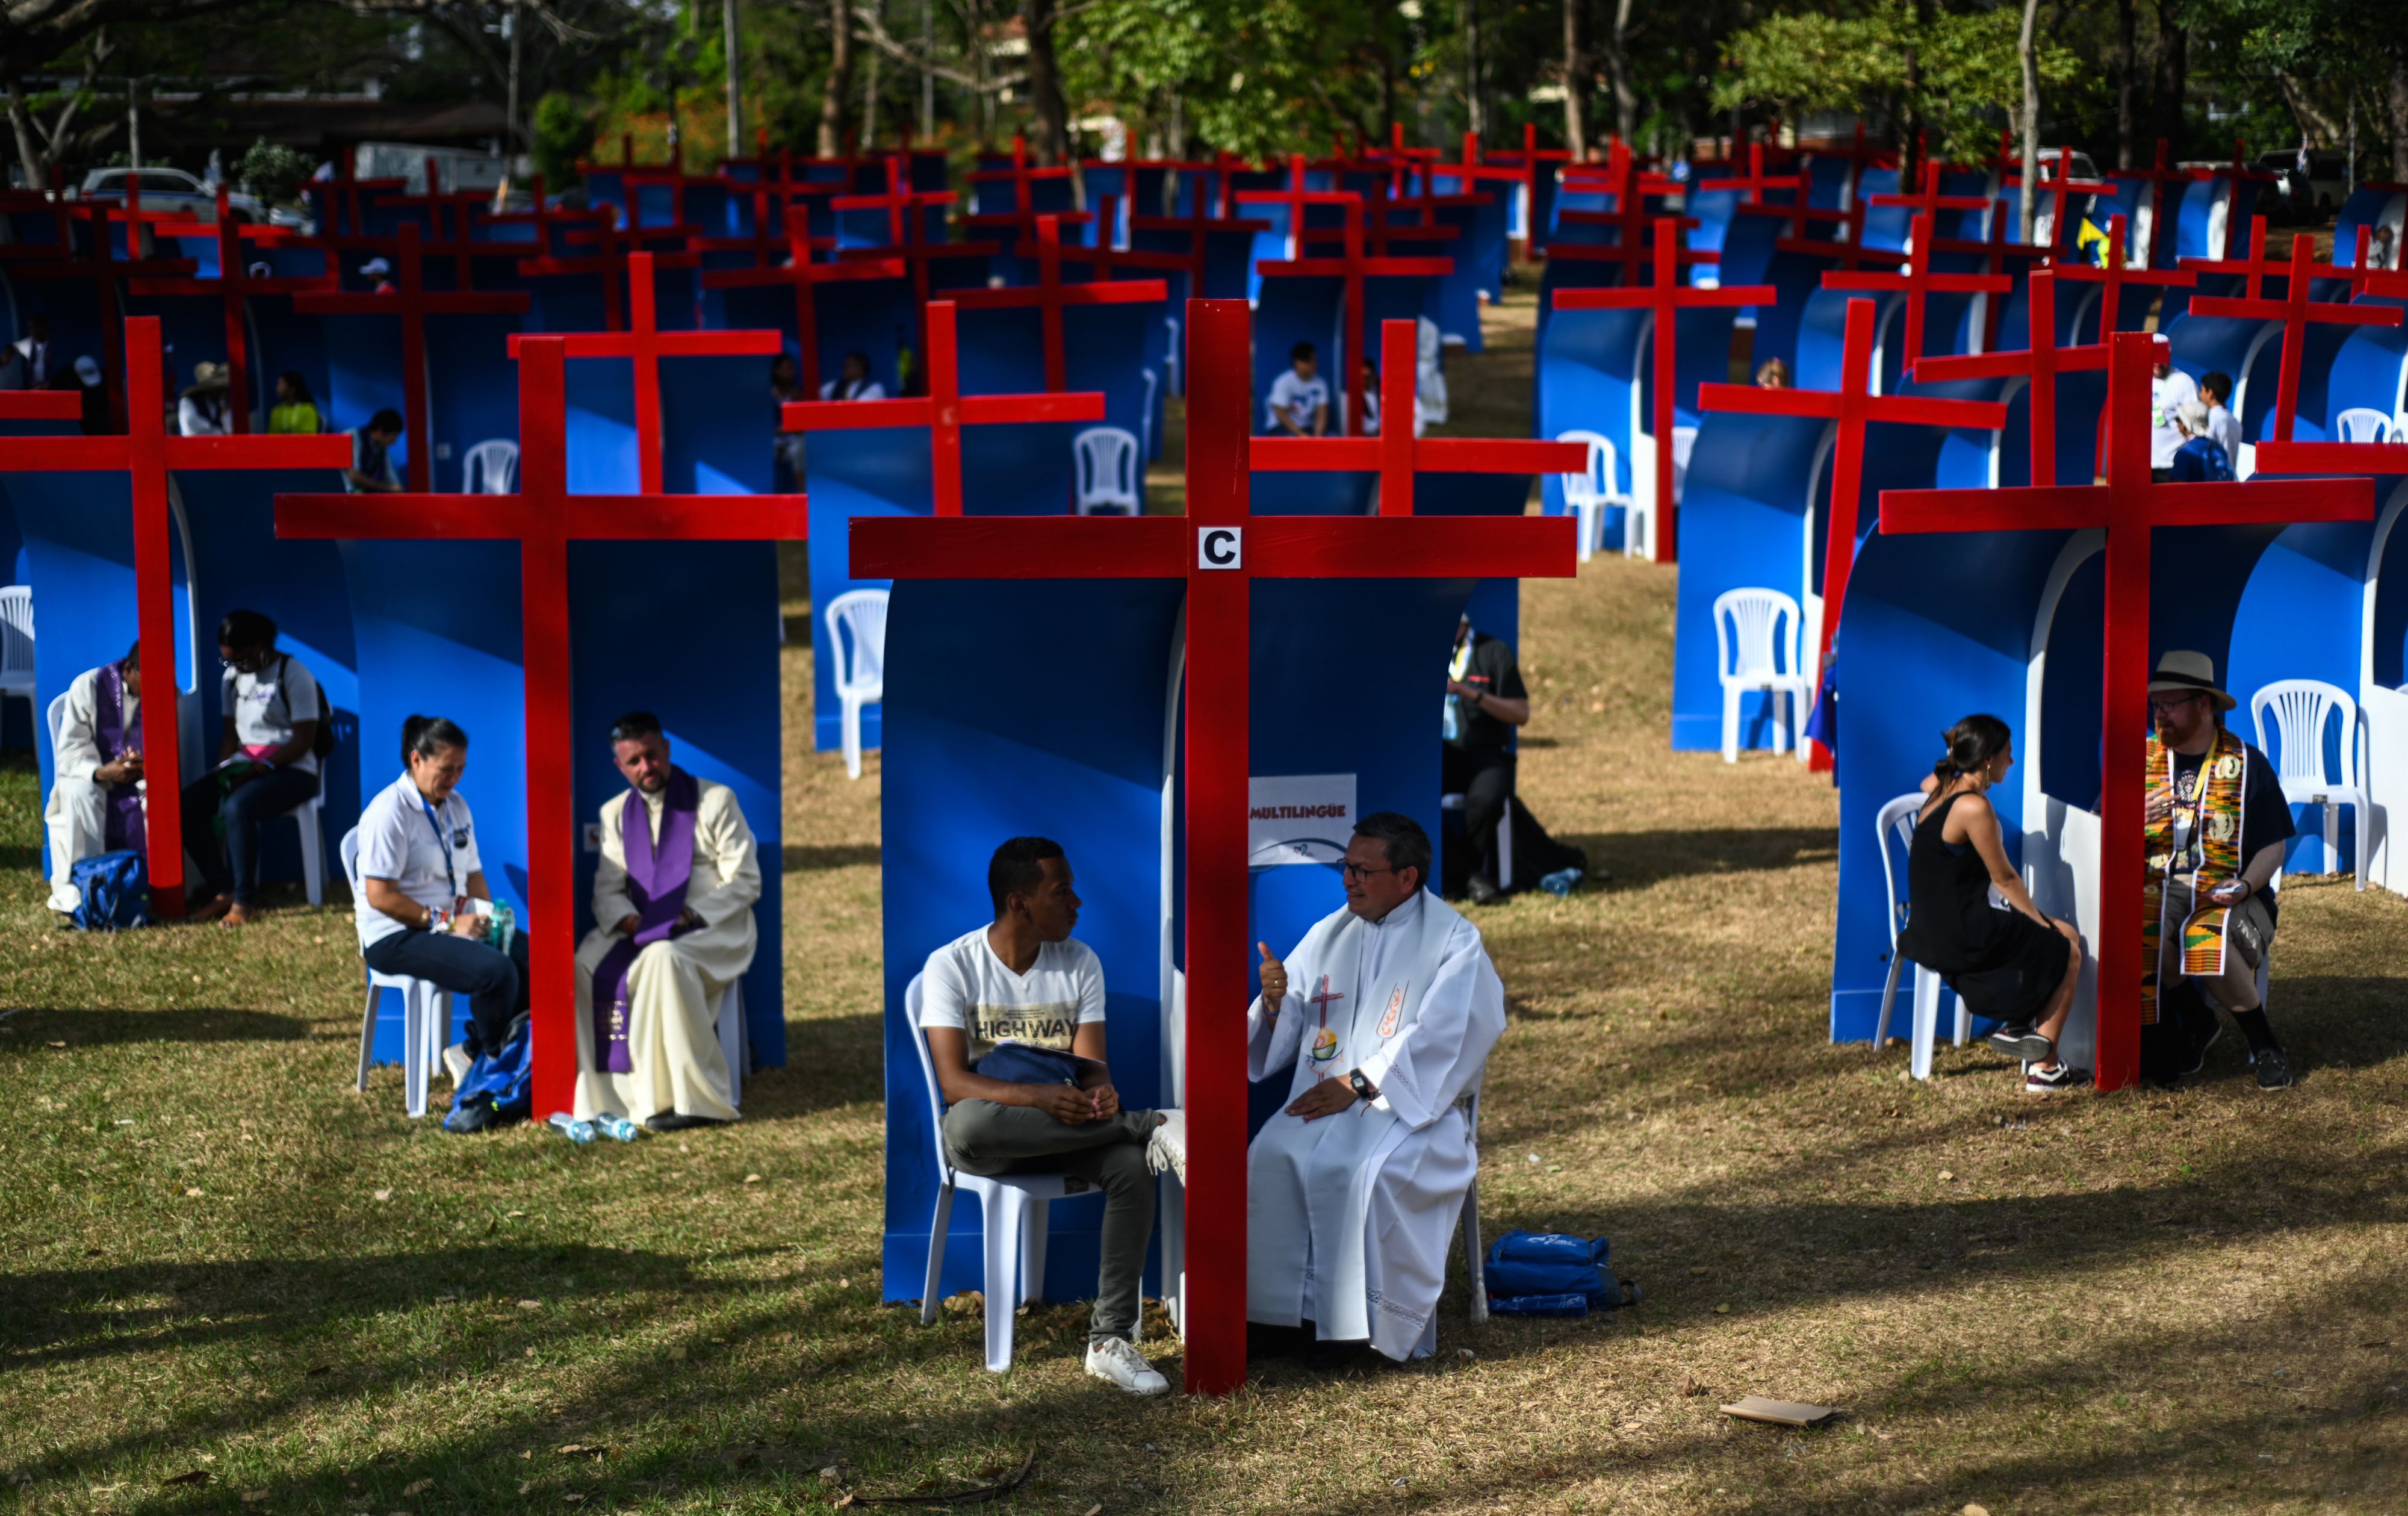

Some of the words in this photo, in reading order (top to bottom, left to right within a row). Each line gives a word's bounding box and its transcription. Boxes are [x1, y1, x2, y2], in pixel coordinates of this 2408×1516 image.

[1203, 530, 1237, 565] C
[1249, 803, 1346, 820] MULTILINGÜE
[975, 1018, 1076, 1040] HIGHWAY
